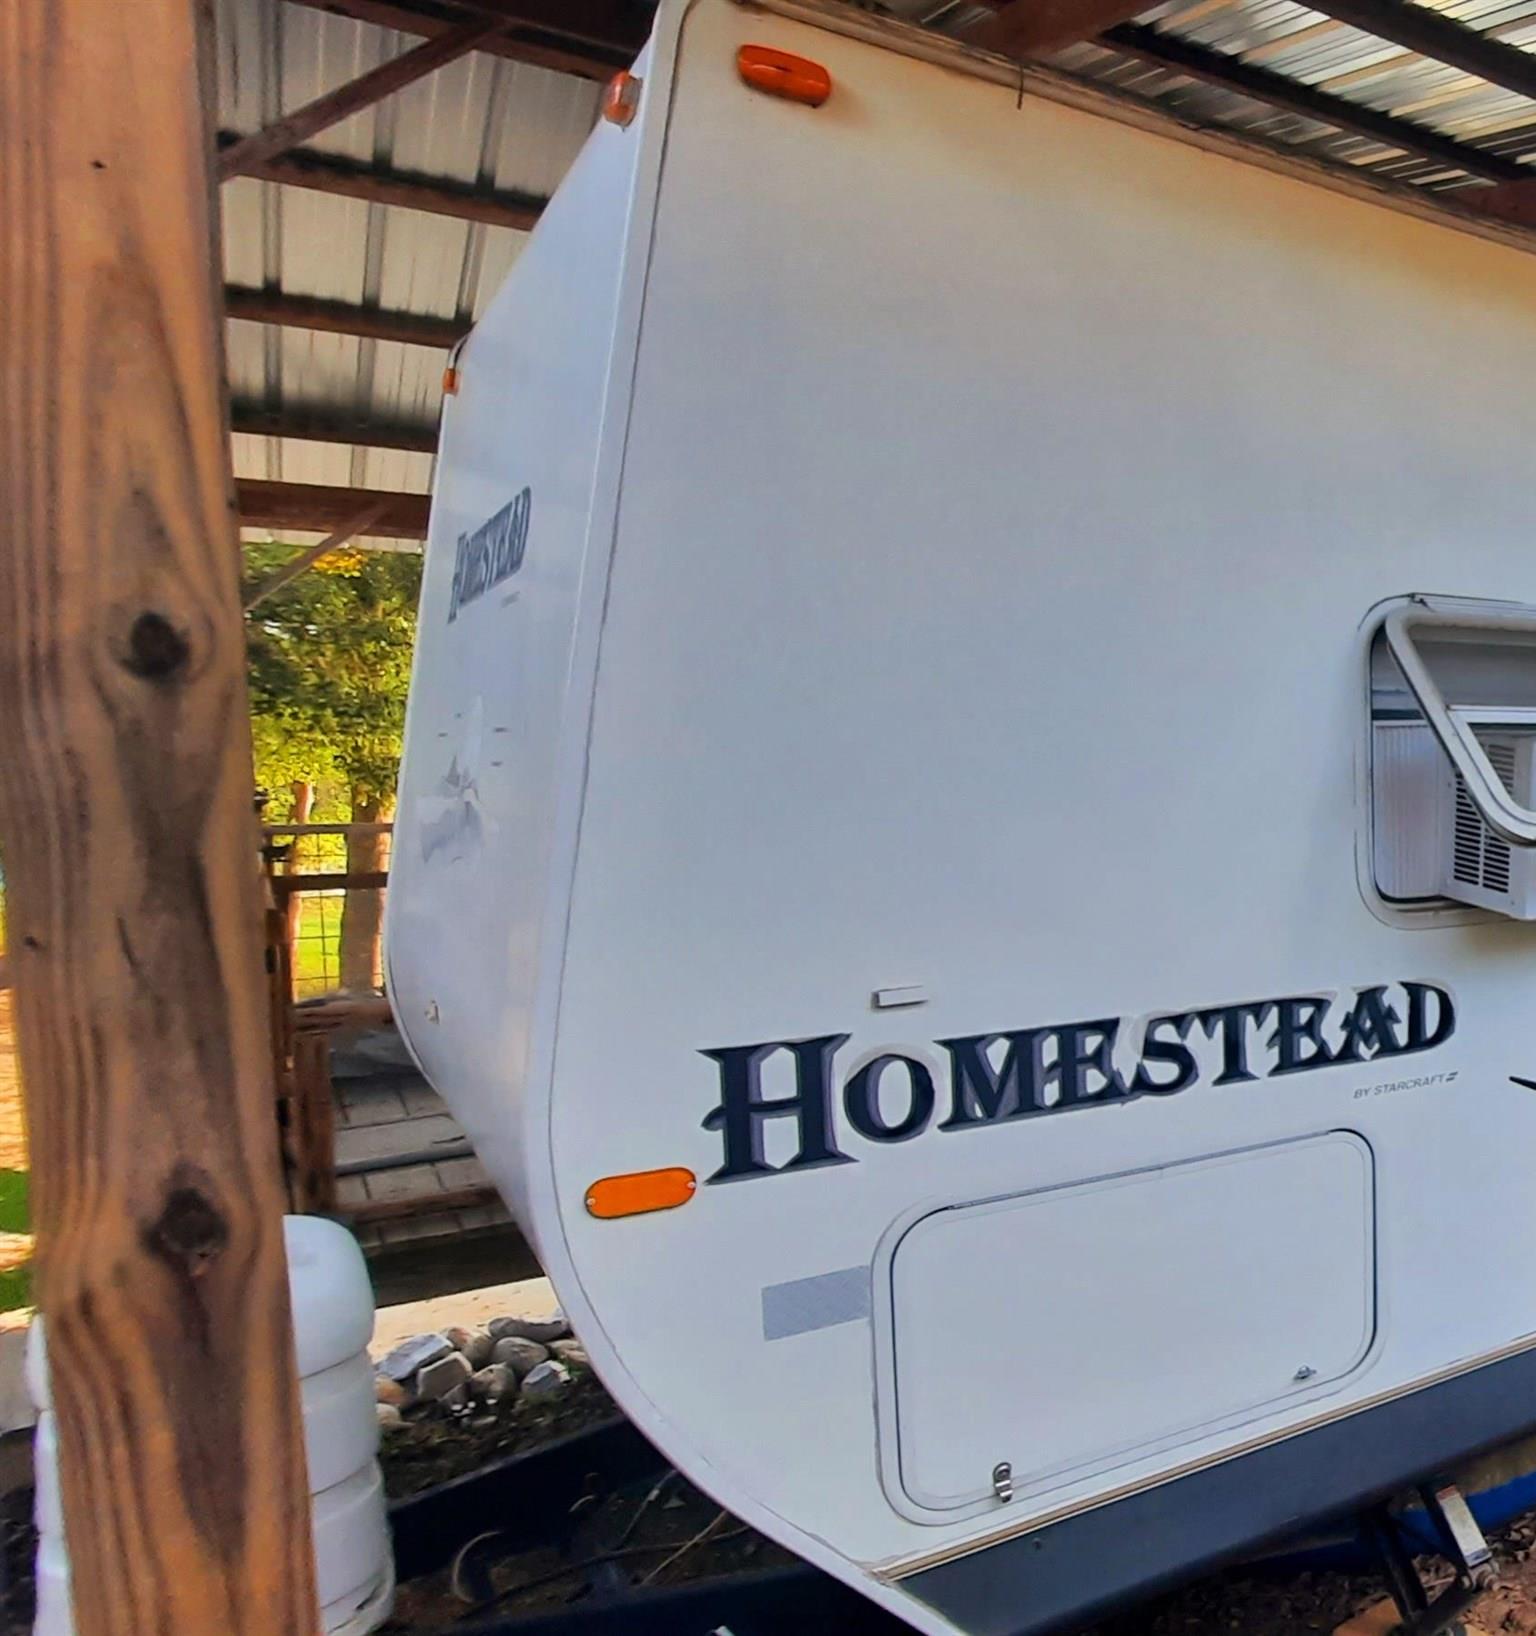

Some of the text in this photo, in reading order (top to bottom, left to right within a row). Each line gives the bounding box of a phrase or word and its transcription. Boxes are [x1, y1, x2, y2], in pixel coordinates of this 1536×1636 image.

[697, 981, 1456, 1184] HOMESTEAD
[1353, 1073, 1445, 1099] BY STARCRAFT
